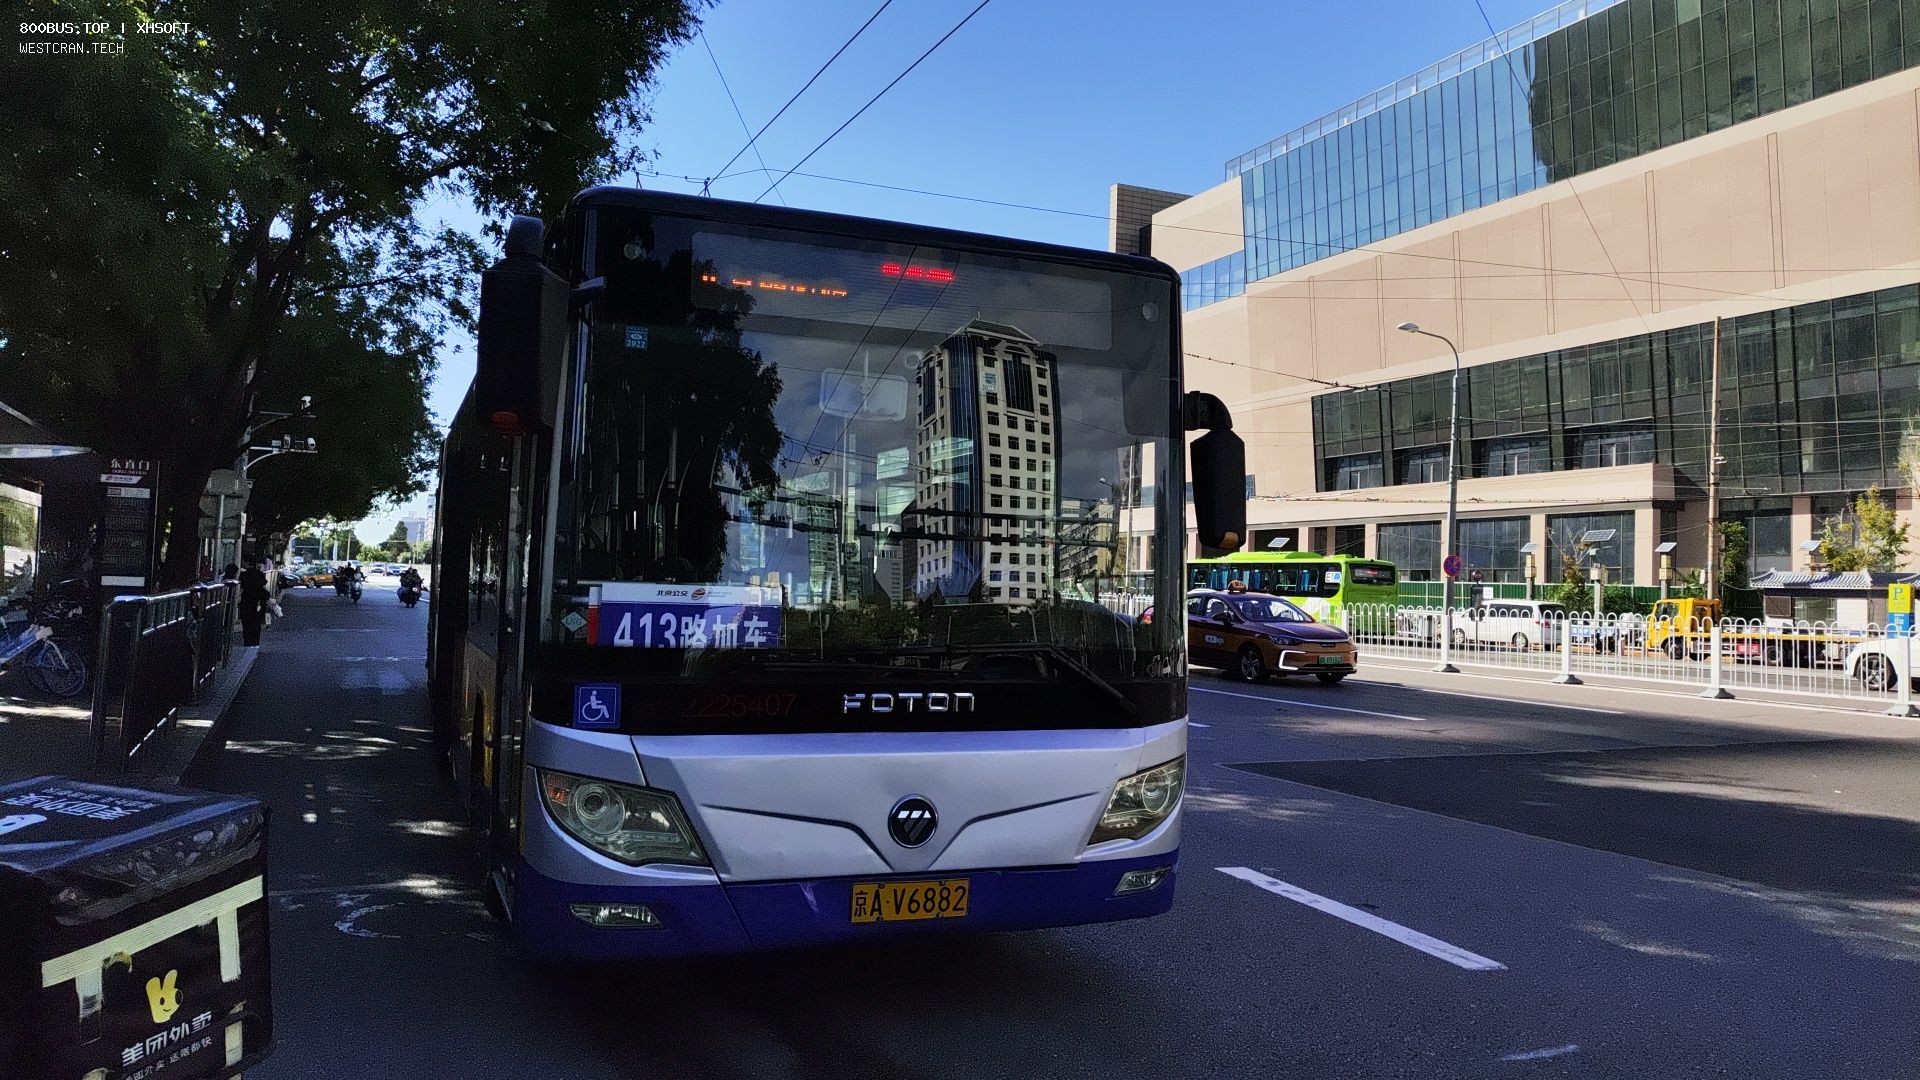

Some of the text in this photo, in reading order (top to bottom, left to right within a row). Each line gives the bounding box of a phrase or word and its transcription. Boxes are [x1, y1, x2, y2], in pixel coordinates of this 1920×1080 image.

[656, 589, 689, 598] 北京公交
[1893, 587, 1904, 600] P
[613, 611, 769, 648] 413路加车
[842, 692, 975, 713] FOTON
[3, 792, 141, 820] 美团外卖
[853, 885, 968, 917] 京A·V6882
[120, 1010, 212, 1067] 美团外卖
